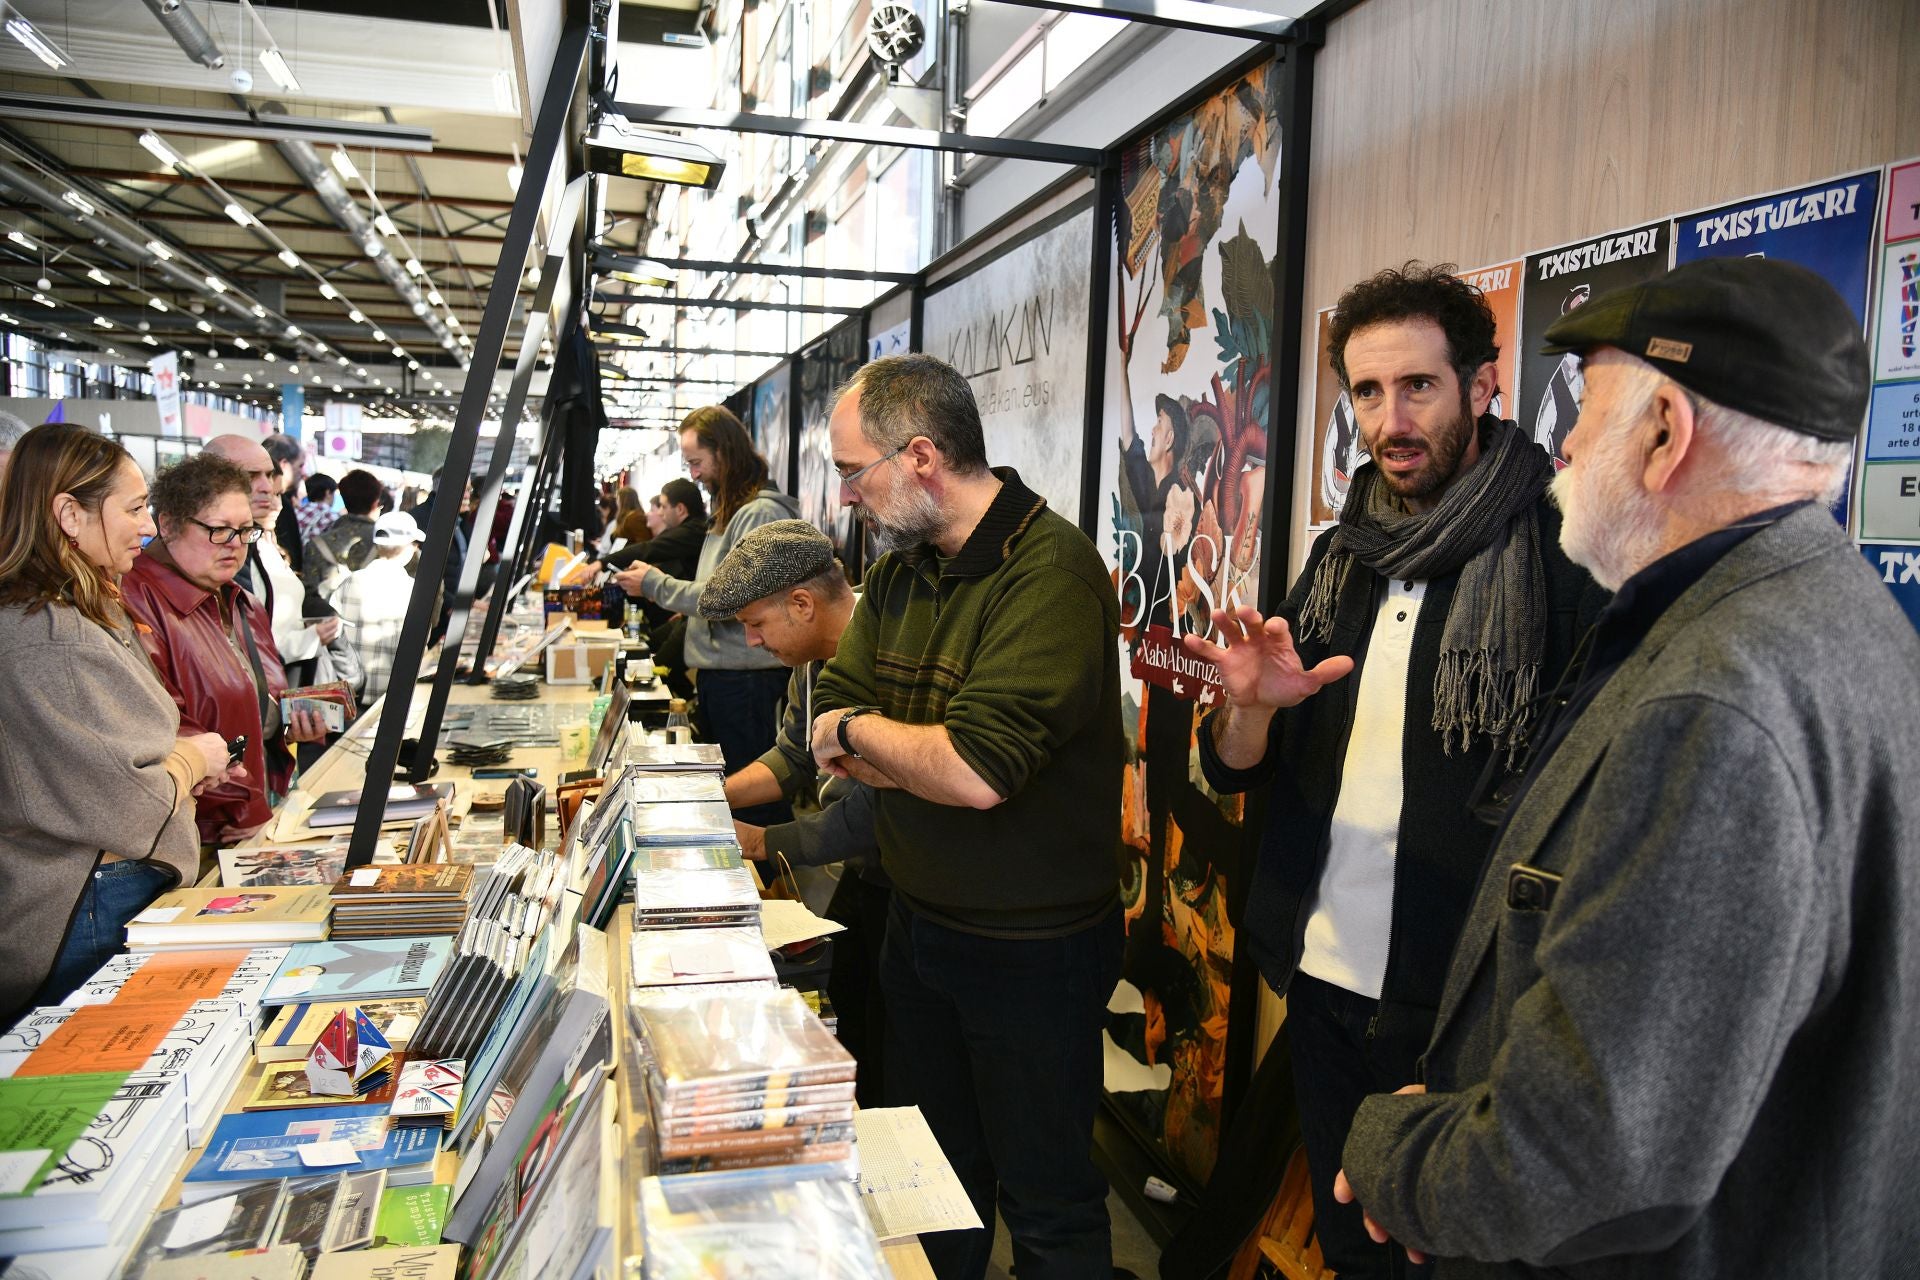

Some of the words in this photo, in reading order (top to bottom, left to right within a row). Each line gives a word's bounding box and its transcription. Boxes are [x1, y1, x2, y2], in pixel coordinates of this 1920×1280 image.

[1696, 184, 1860, 248] TXISTULARI
[1538, 228, 1658, 281] TXISTULARI
[1903, 409, 1920, 419] urt
[1901, 423, 1914, 433] 18
[1888, 438, 1910, 448] arte
